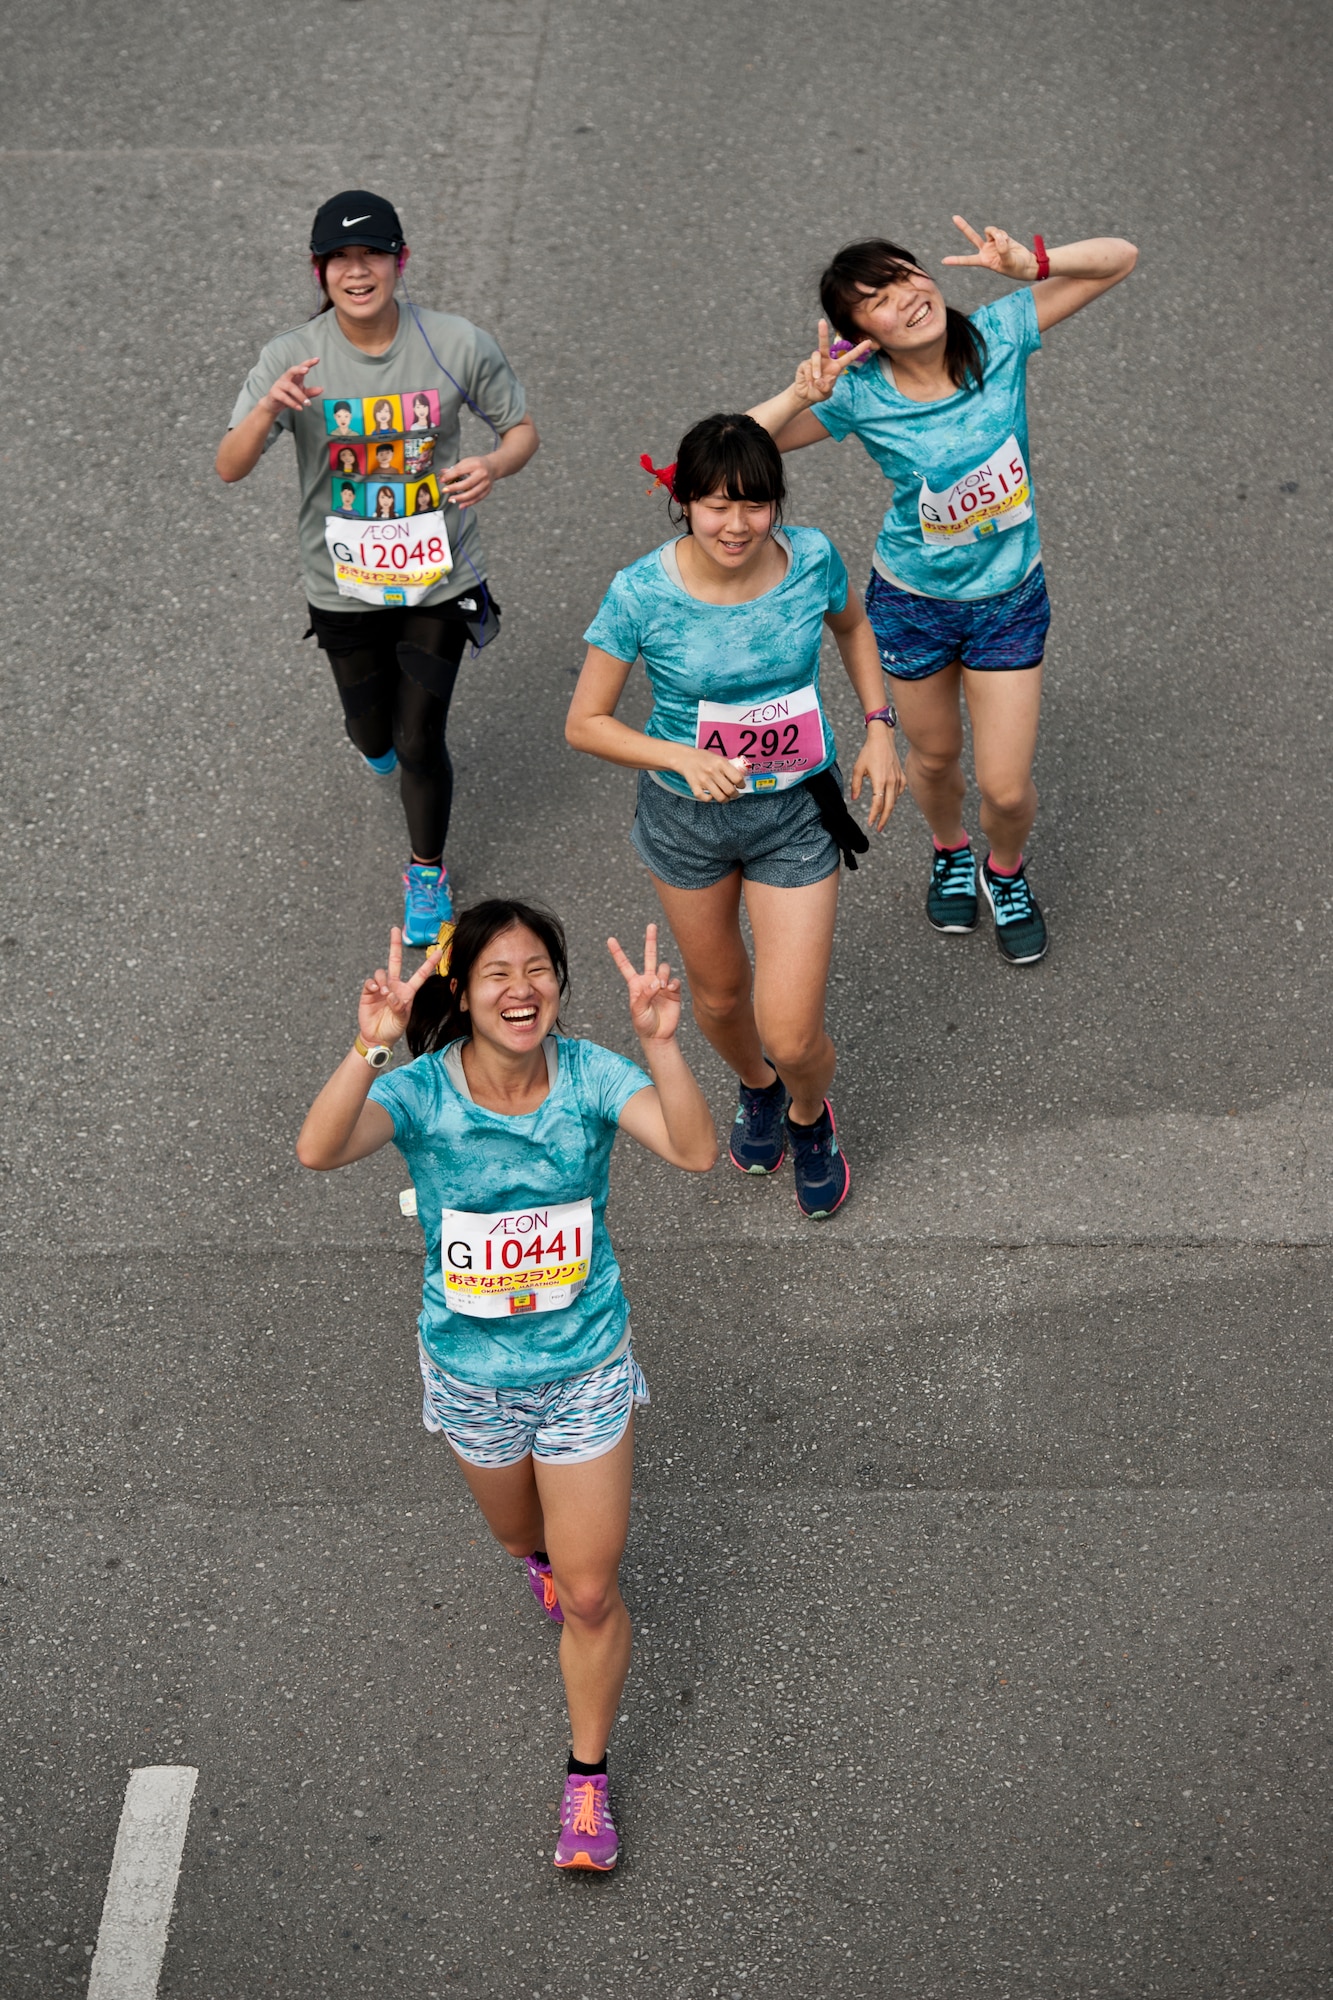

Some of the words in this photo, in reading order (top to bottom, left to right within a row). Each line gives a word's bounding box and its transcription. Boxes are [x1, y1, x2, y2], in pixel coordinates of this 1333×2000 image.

[737, 724, 799, 758] 292
[448, 1266, 575, 1288] おきなわマラソン
[481, 1286, 516, 1294] OKINAWA
[519, 1280, 560, 1289] MARATHON
